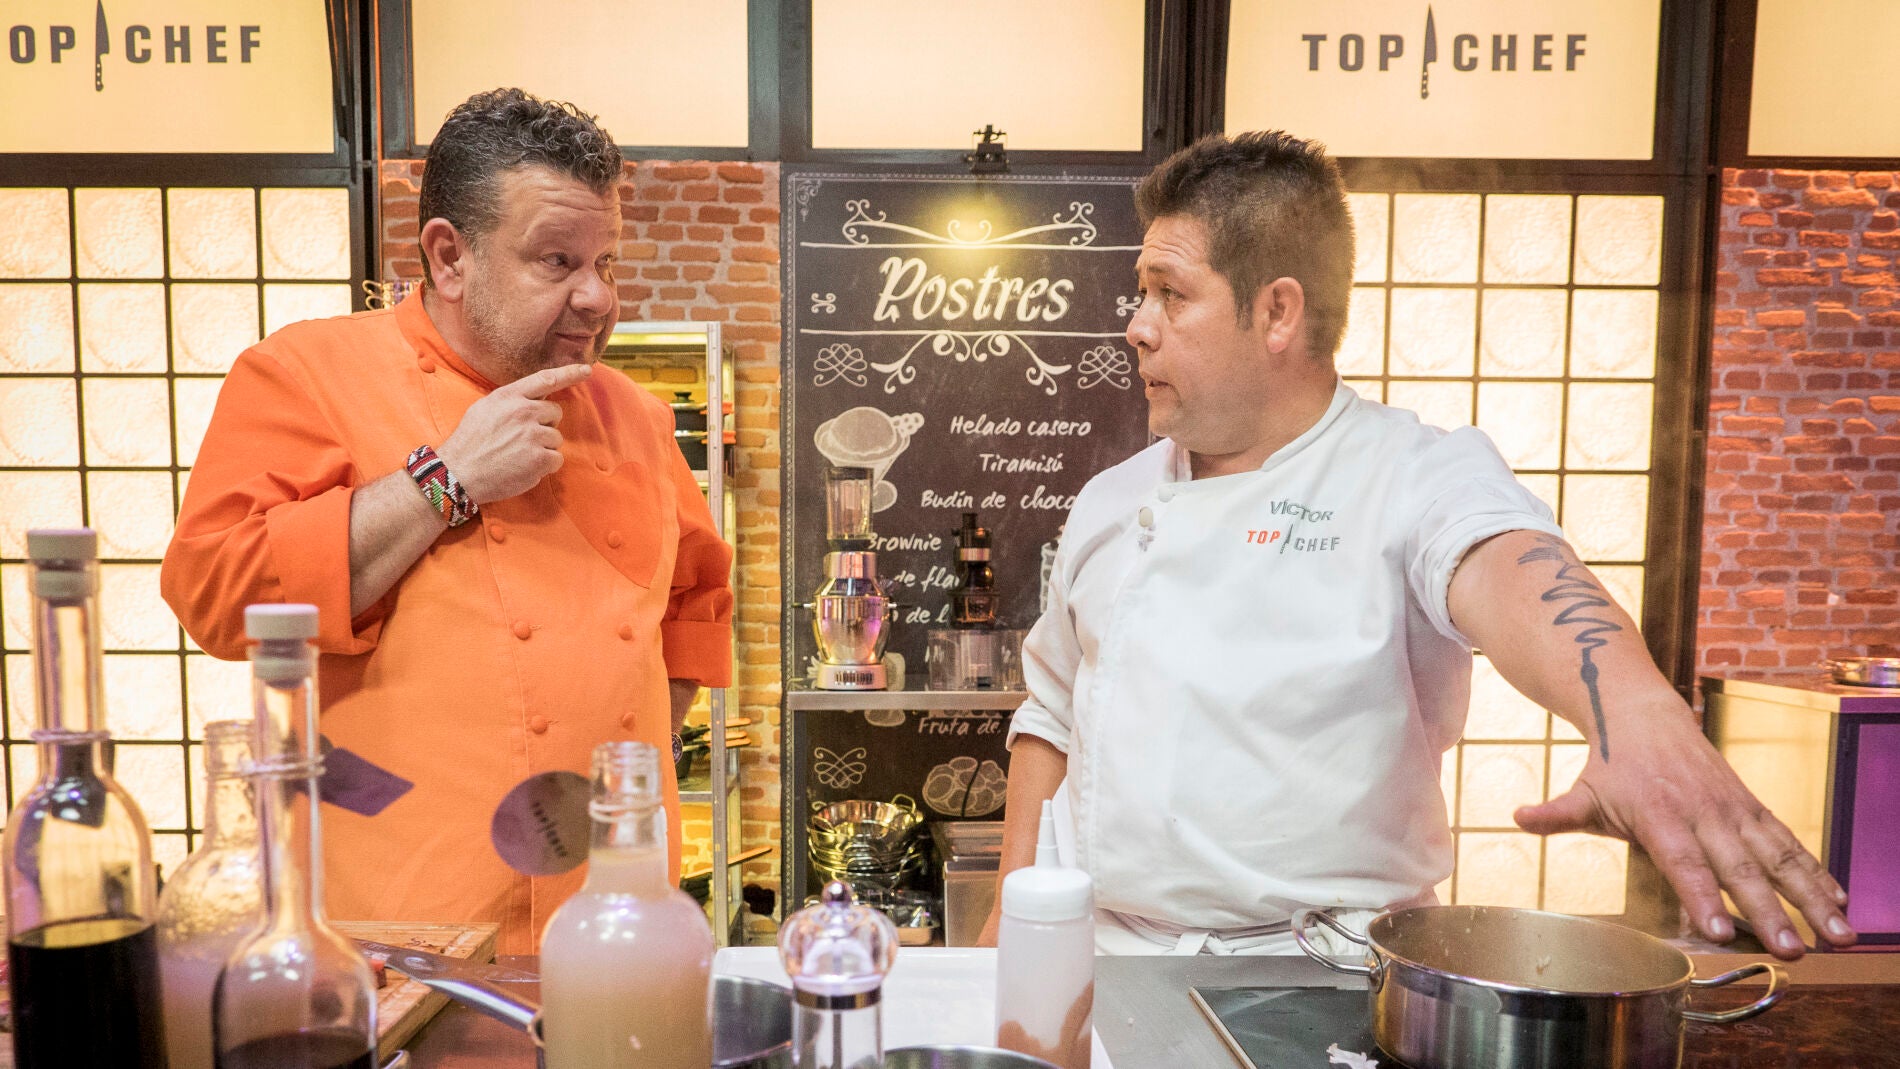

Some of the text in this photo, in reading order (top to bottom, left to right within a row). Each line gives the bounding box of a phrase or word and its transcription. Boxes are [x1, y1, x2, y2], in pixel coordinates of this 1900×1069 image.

[125, 25, 261, 64] CHEF
[1301, 33, 1587, 72] TOP CHEF
[873, 256, 1075, 323] Postres
[950, 413, 1092, 436] Helado casero
[979, 452, 1064, 473] Tiramisú
[920, 489, 974, 509] Budín
[980, 491, 1007, 509] de
[1270, 498, 1334, 523] VÍCTOR
[868, 532, 942, 552] Brownie
[1246, 529, 1341, 552] TOP CHEF
[905, 606, 931, 624] de
[917, 717, 1001, 736] Fruta de
